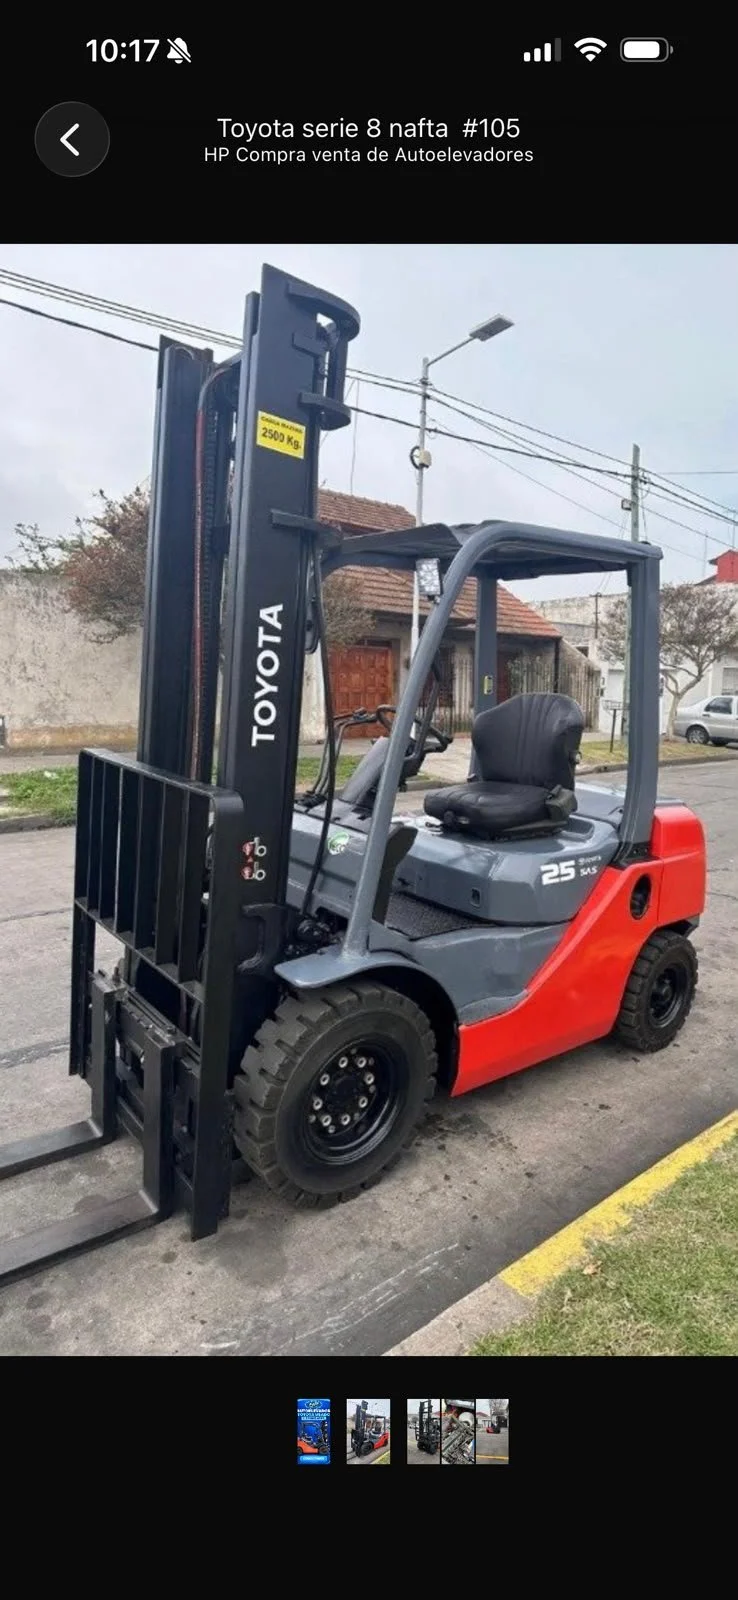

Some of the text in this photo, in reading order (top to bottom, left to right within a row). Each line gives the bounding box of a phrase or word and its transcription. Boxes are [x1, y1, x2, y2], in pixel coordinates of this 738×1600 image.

[262, 427, 284, 442] 2500
[252, 604, 283, 746] TOYOTA
[540, 860, 576, 885] 25
